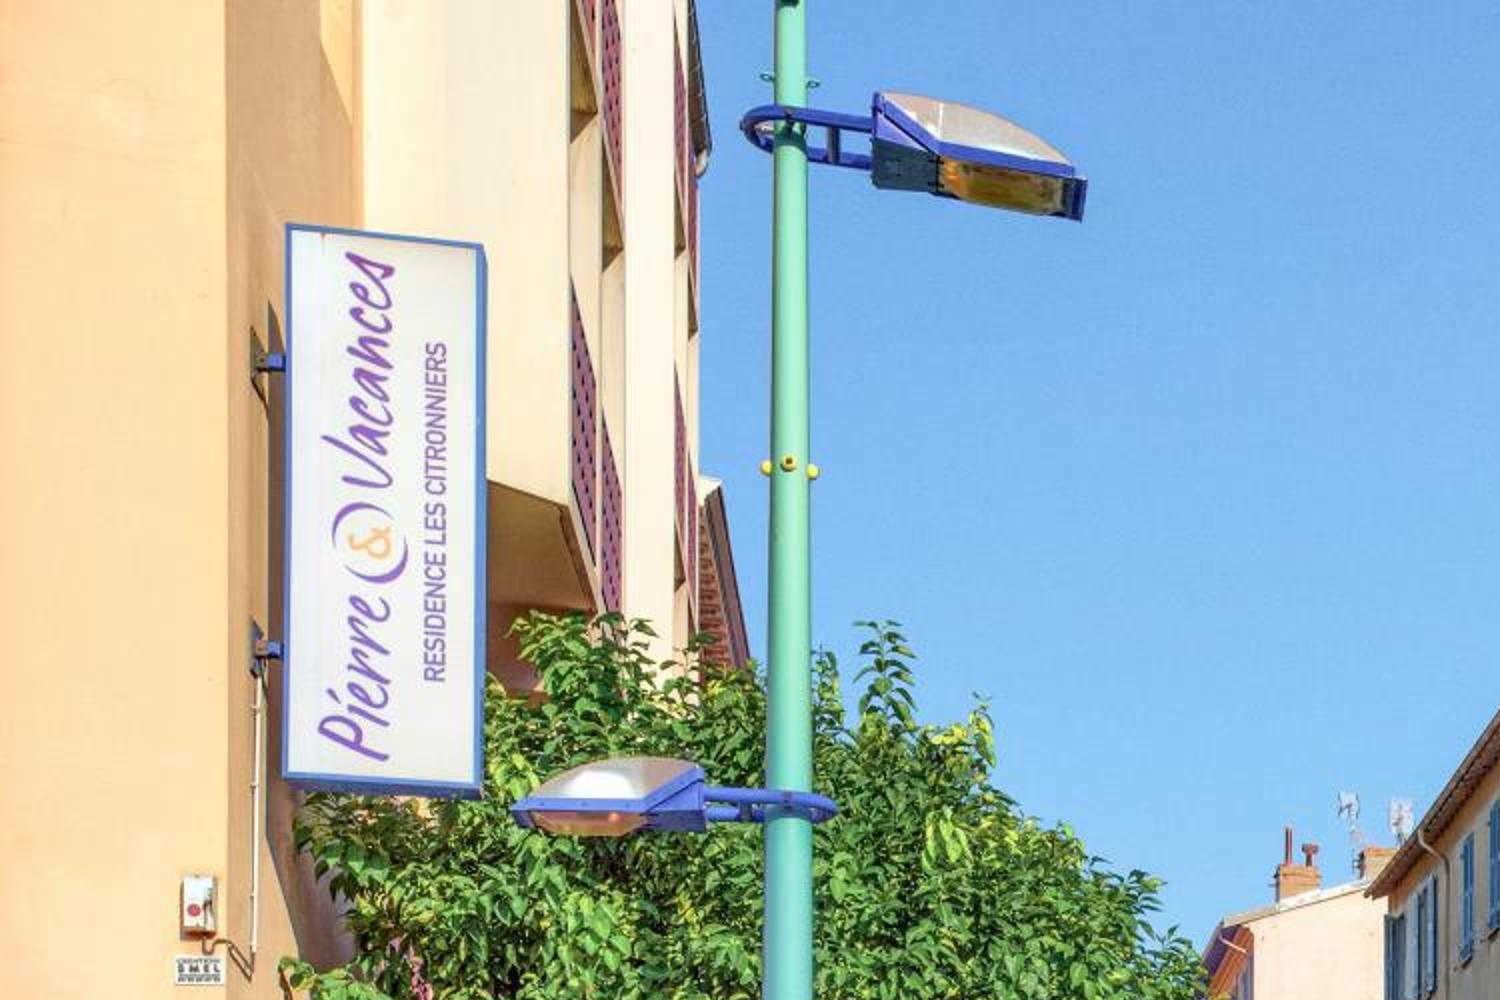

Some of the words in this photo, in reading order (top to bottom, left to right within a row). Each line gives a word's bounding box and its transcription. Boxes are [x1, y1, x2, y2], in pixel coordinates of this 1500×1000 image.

[321, 251, 396, 490] Vacances
[424, 341, 448, 495] CITRONNIERS
[424, 502, 447, 545] LES
[318, 596, 391, 762] Pierre
[423, 552, 447, 683] RESIDENCE
